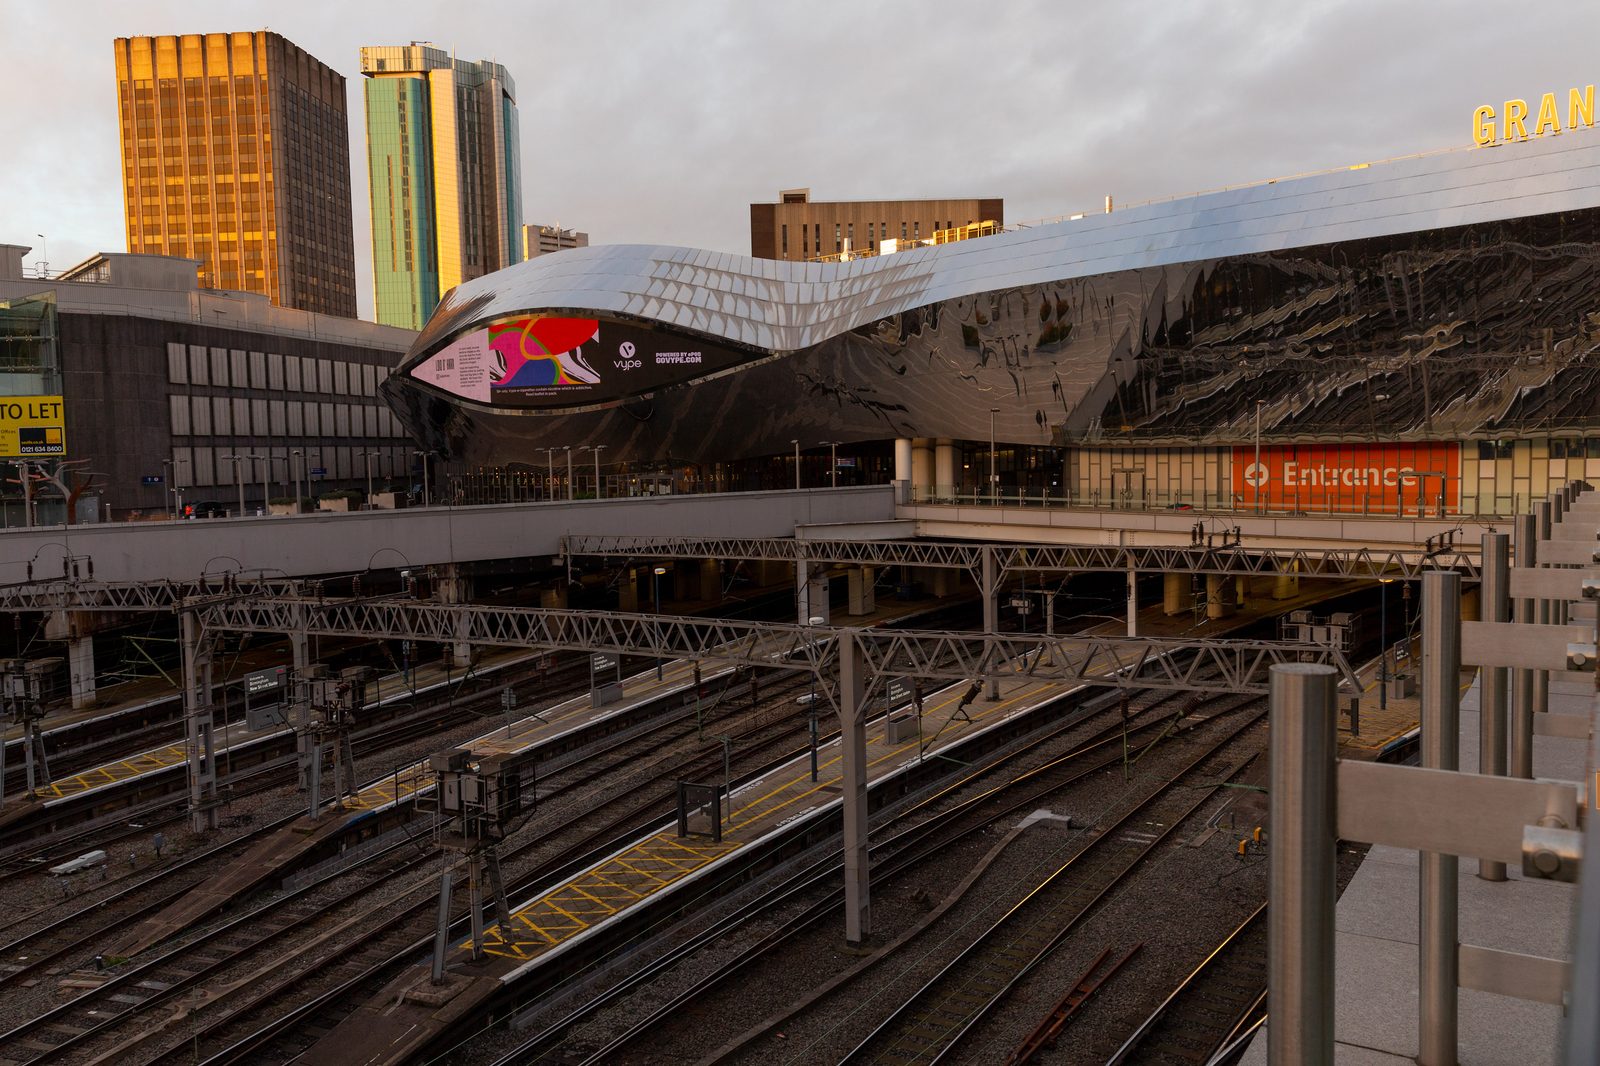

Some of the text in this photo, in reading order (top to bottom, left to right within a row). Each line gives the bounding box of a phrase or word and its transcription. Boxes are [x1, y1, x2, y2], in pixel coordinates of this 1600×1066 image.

[1473, 84, 1595, 145] GRAN
[613, 360, 642, 371] vype
[0, 403, 61, 419] TO LET
[1284, 461, 1416, 487] Entrance
